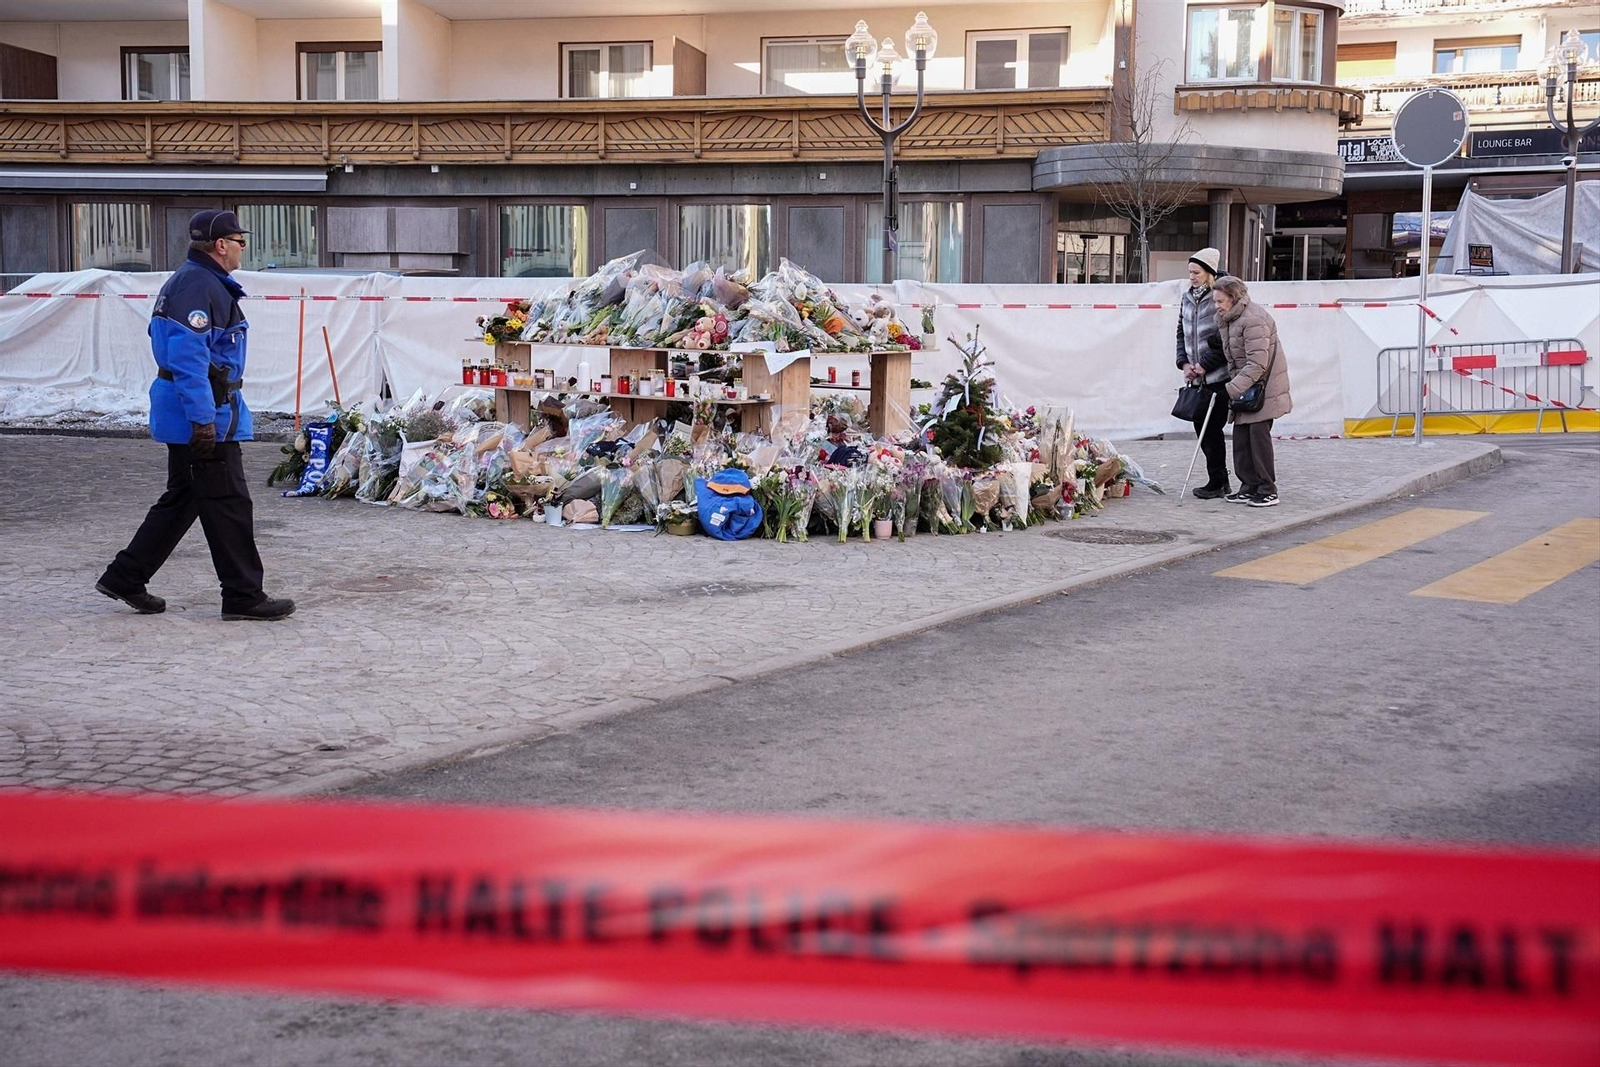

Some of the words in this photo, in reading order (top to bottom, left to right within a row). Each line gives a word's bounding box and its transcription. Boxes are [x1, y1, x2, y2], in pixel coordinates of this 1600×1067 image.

[1339, 141, 1365, 157] ntal
[1478, 139, 1513, 149] LOUNGE
[1514, 138, 1532, 147] BAR
[412, 866, 608, 944] HALTE
[645, 884, 898, 962] POLICE
[966, 897, 1340, 984] Sperrzone
[1376, 914, 1578, 997] HALT
